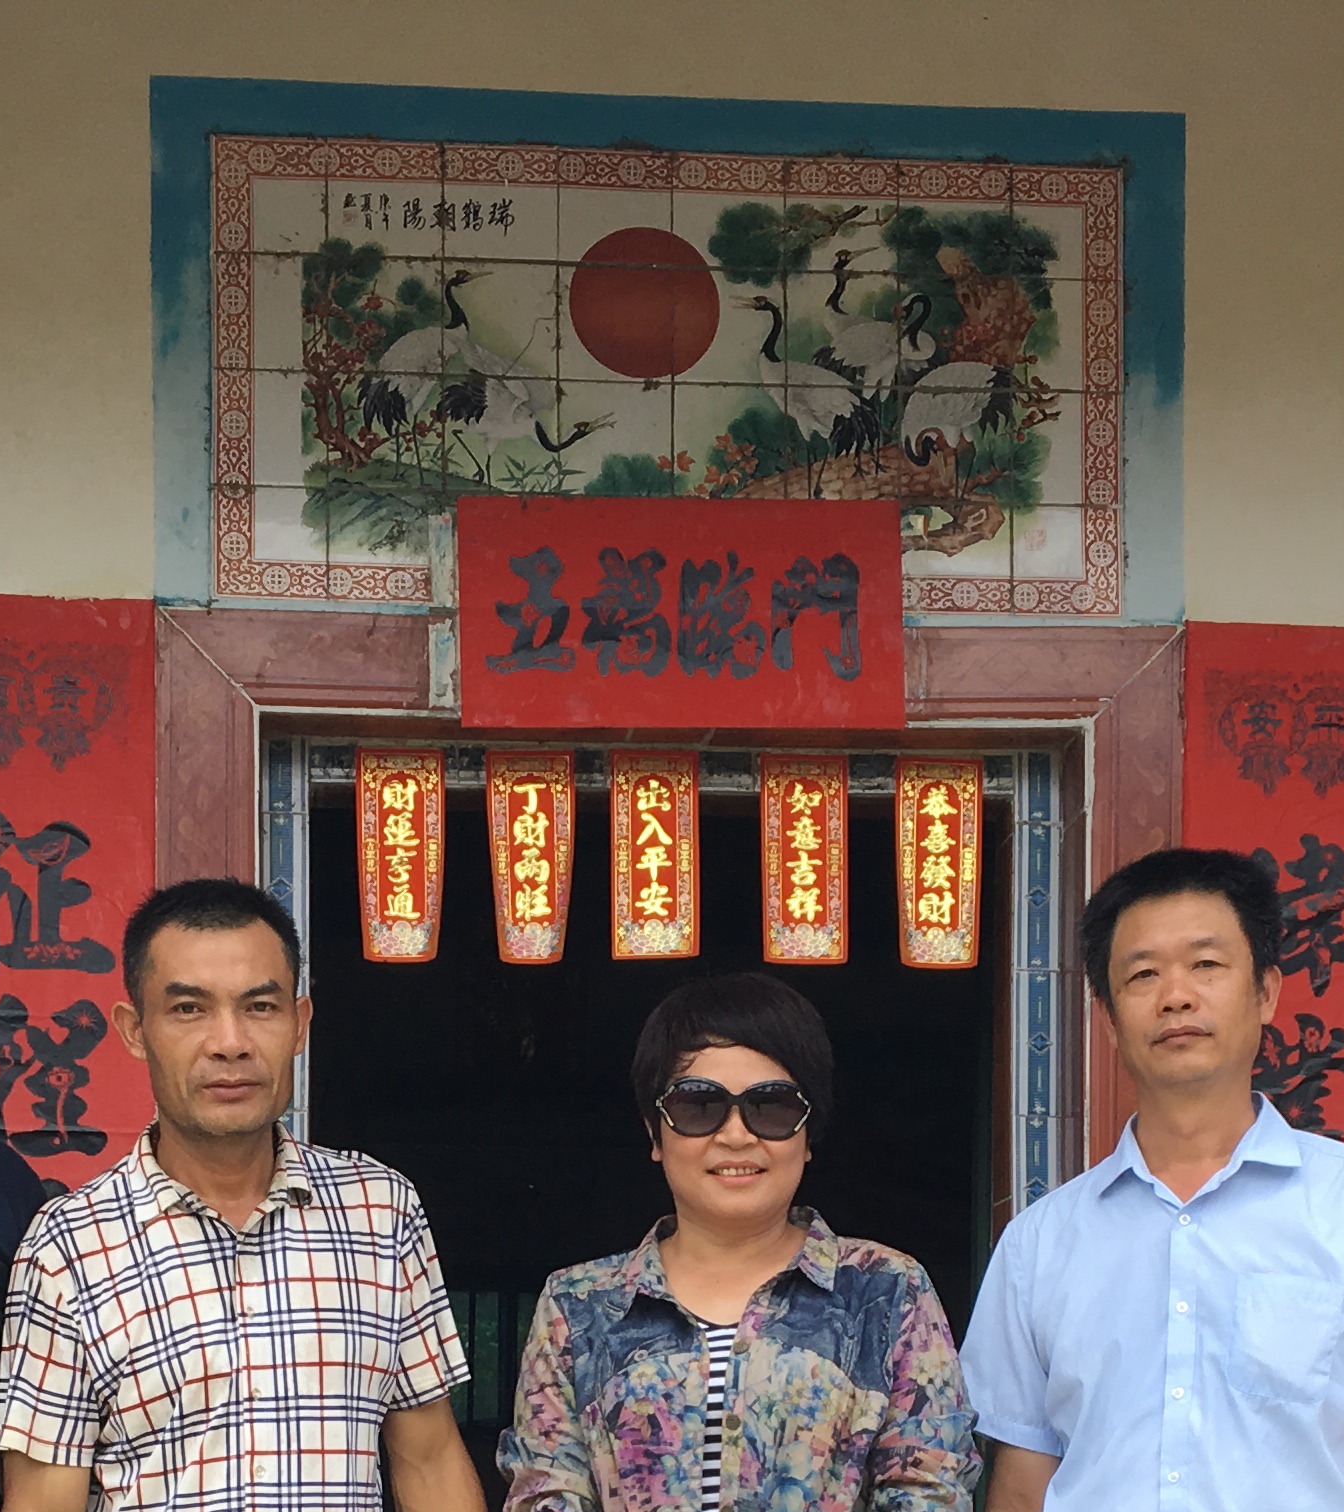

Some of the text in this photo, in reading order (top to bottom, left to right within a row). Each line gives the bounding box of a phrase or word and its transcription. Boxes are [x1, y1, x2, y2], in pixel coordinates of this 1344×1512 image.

[635, 779, 673, 917] 出入平安
[786, 783, 823, 922] 如意吉祥
